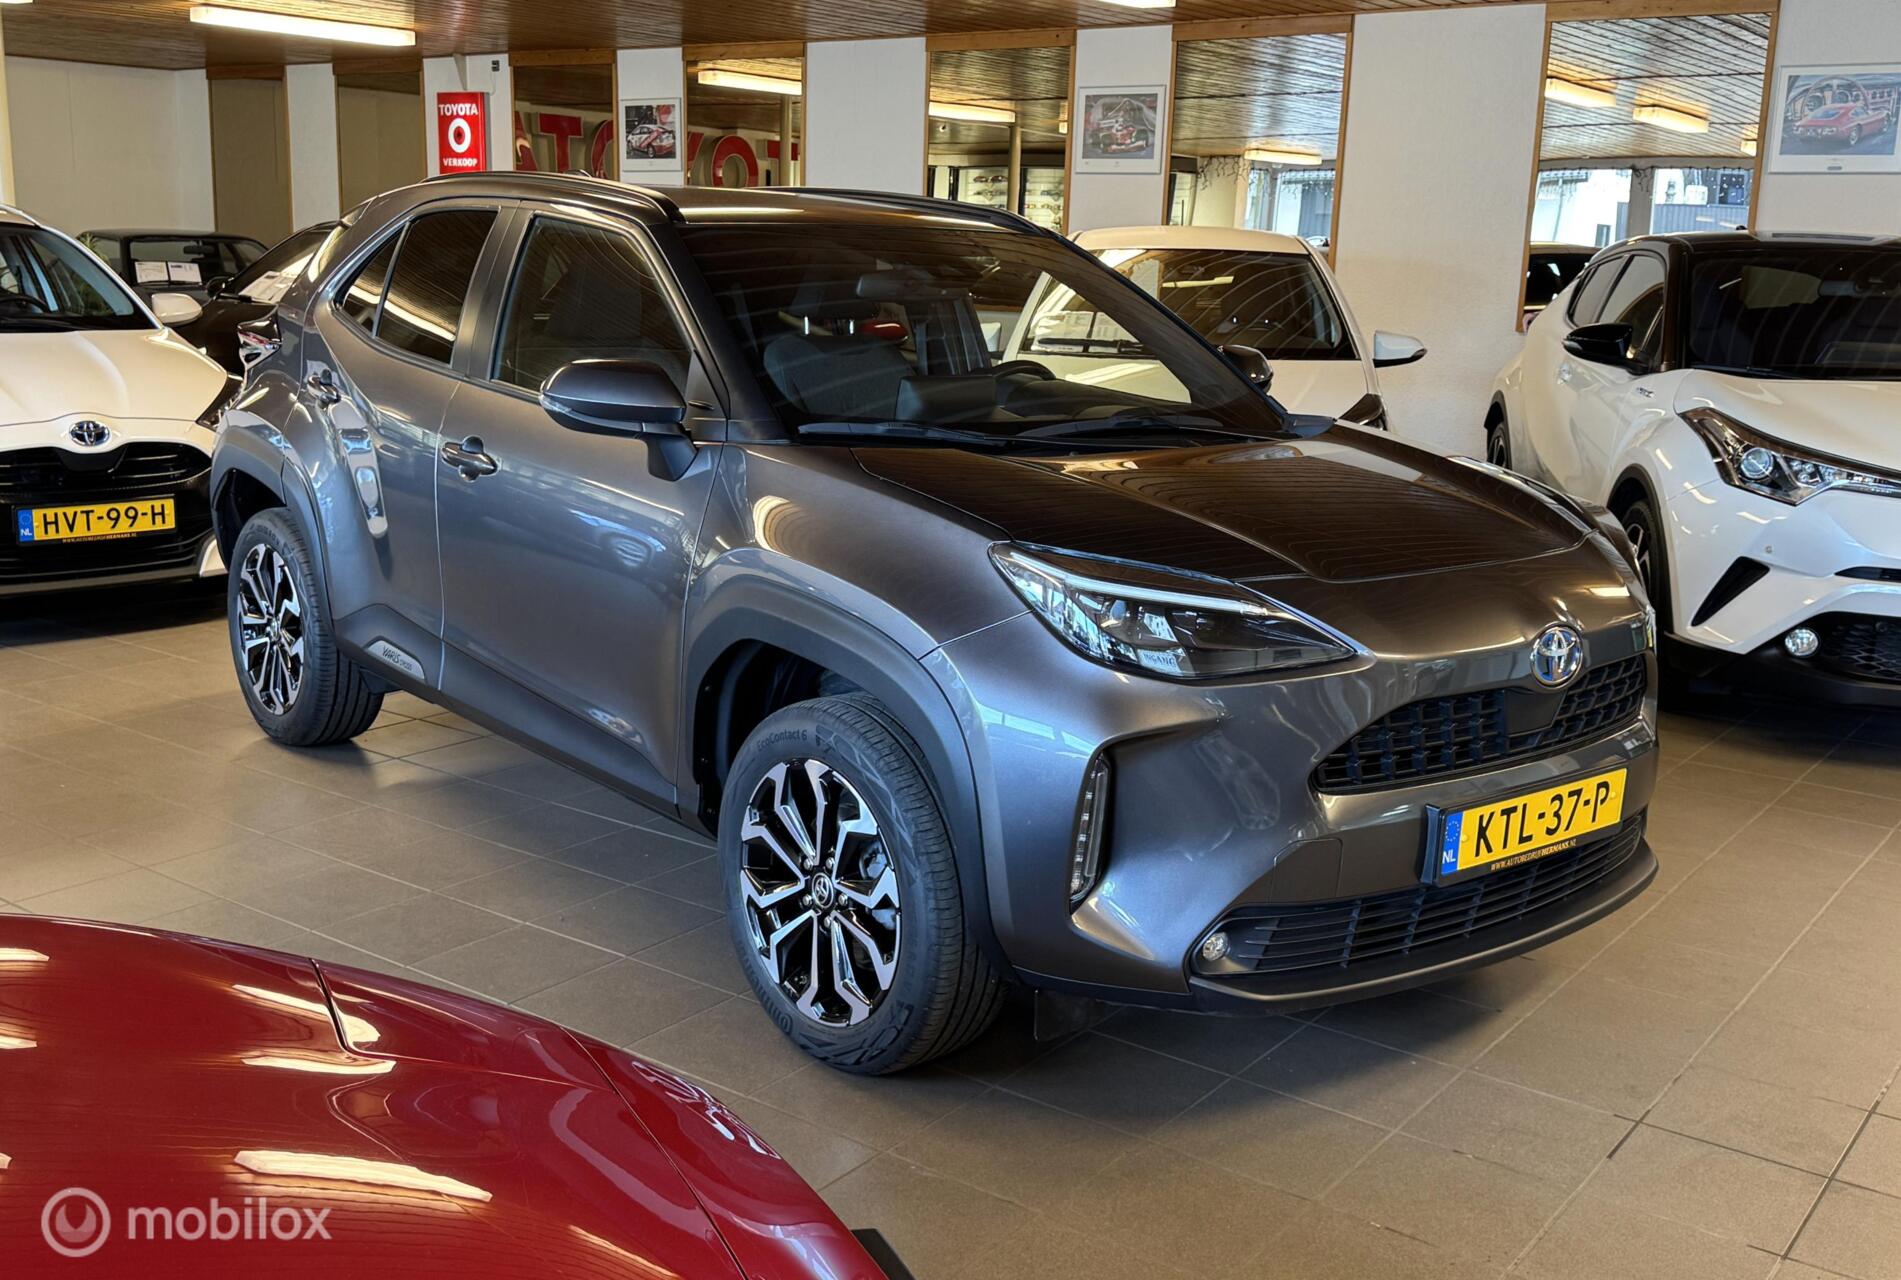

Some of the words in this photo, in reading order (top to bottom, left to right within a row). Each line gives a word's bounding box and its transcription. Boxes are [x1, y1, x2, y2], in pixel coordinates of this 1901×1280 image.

[439, 103, 478, 116] TOYOTA
[443, 158, 478, 167] VERKOOP
[42, 504, 167, 535] HVT-99-H
[20, 528, 33, 536] NL
[1475, 781, 1610, 857] KTL-37-P
[1442, 850, 1456, 864] NL
